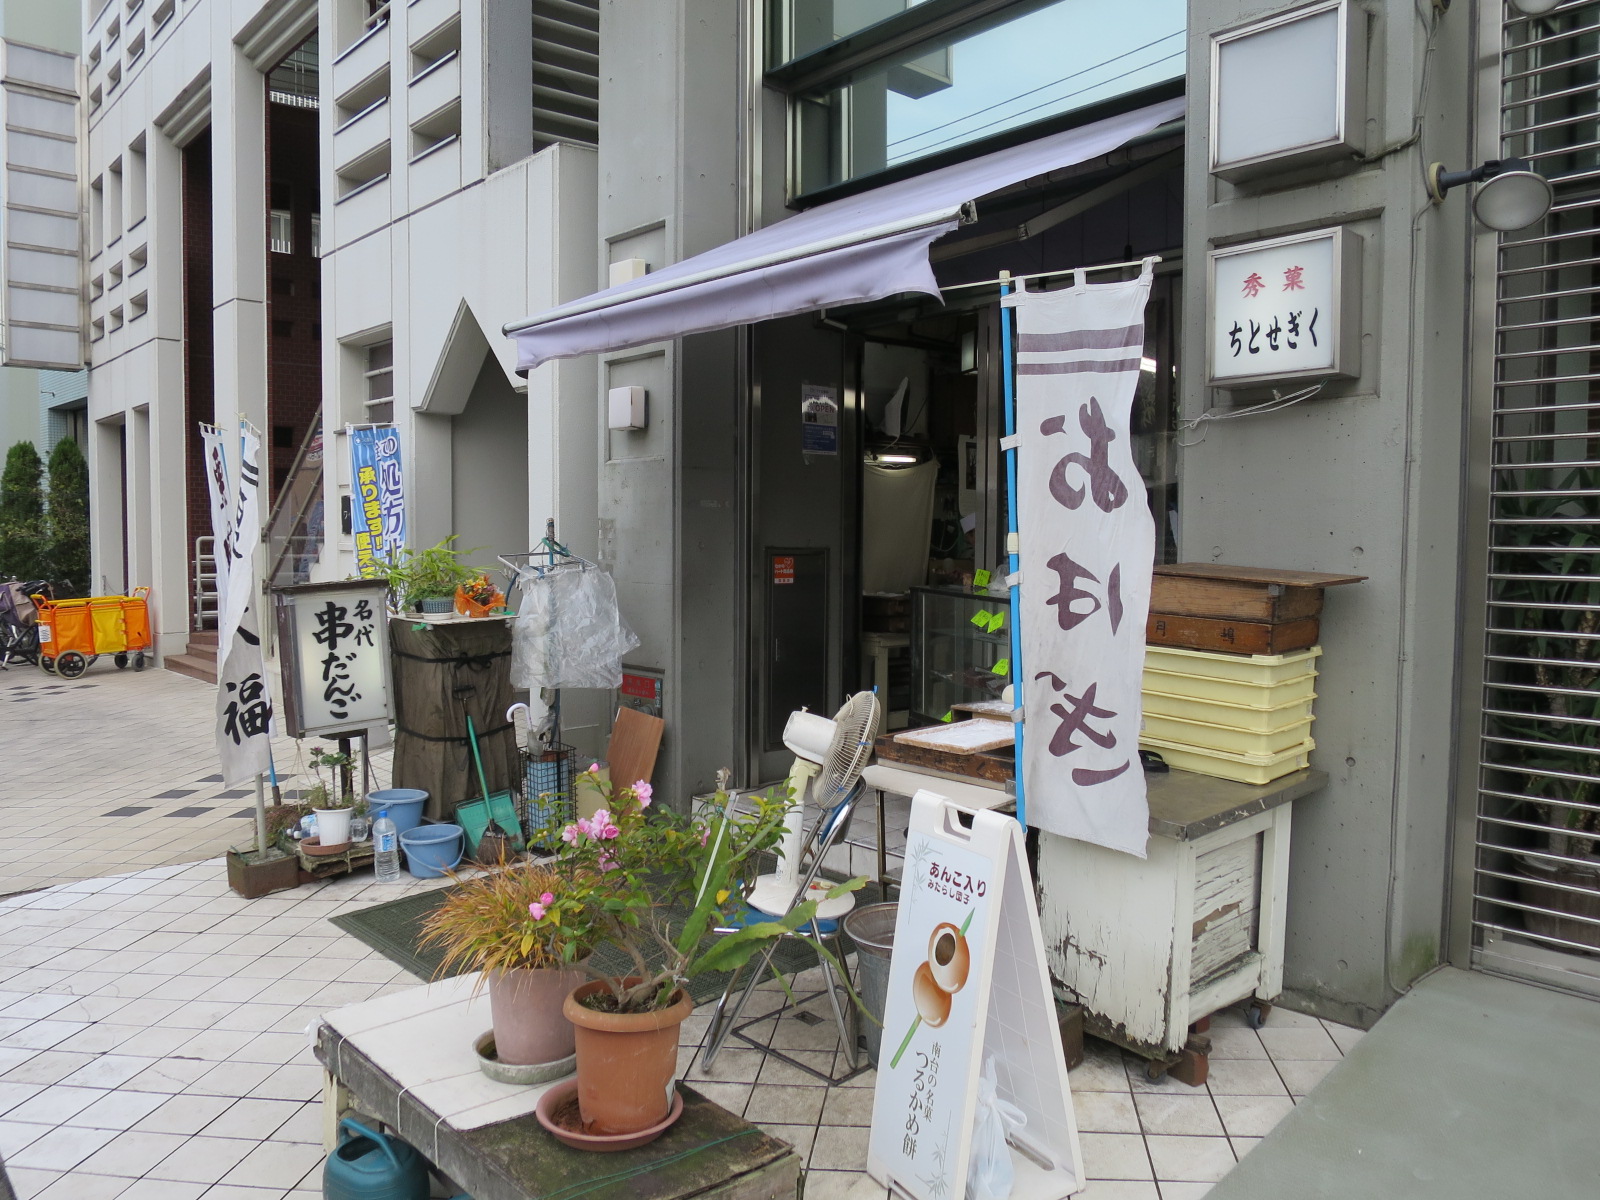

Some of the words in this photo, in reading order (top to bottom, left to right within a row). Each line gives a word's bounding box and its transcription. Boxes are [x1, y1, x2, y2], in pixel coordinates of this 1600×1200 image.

[1241, 265, 1306, 299] 秀菓
[1228, 307, 1319, 358] ちとせぎく
[815, 404, 836, 414] OPEN
[353, 600, 375, 647] 名代
[312, 601, 362, 720] 串だんご
[927, 878, 970, 905] みたらし団子
[929, 861, 987, 898] あんこ入り
[902, 1050, 929, 1161] つるかめ餅
[924, 1041, 942, 1123] 南台の名菓
